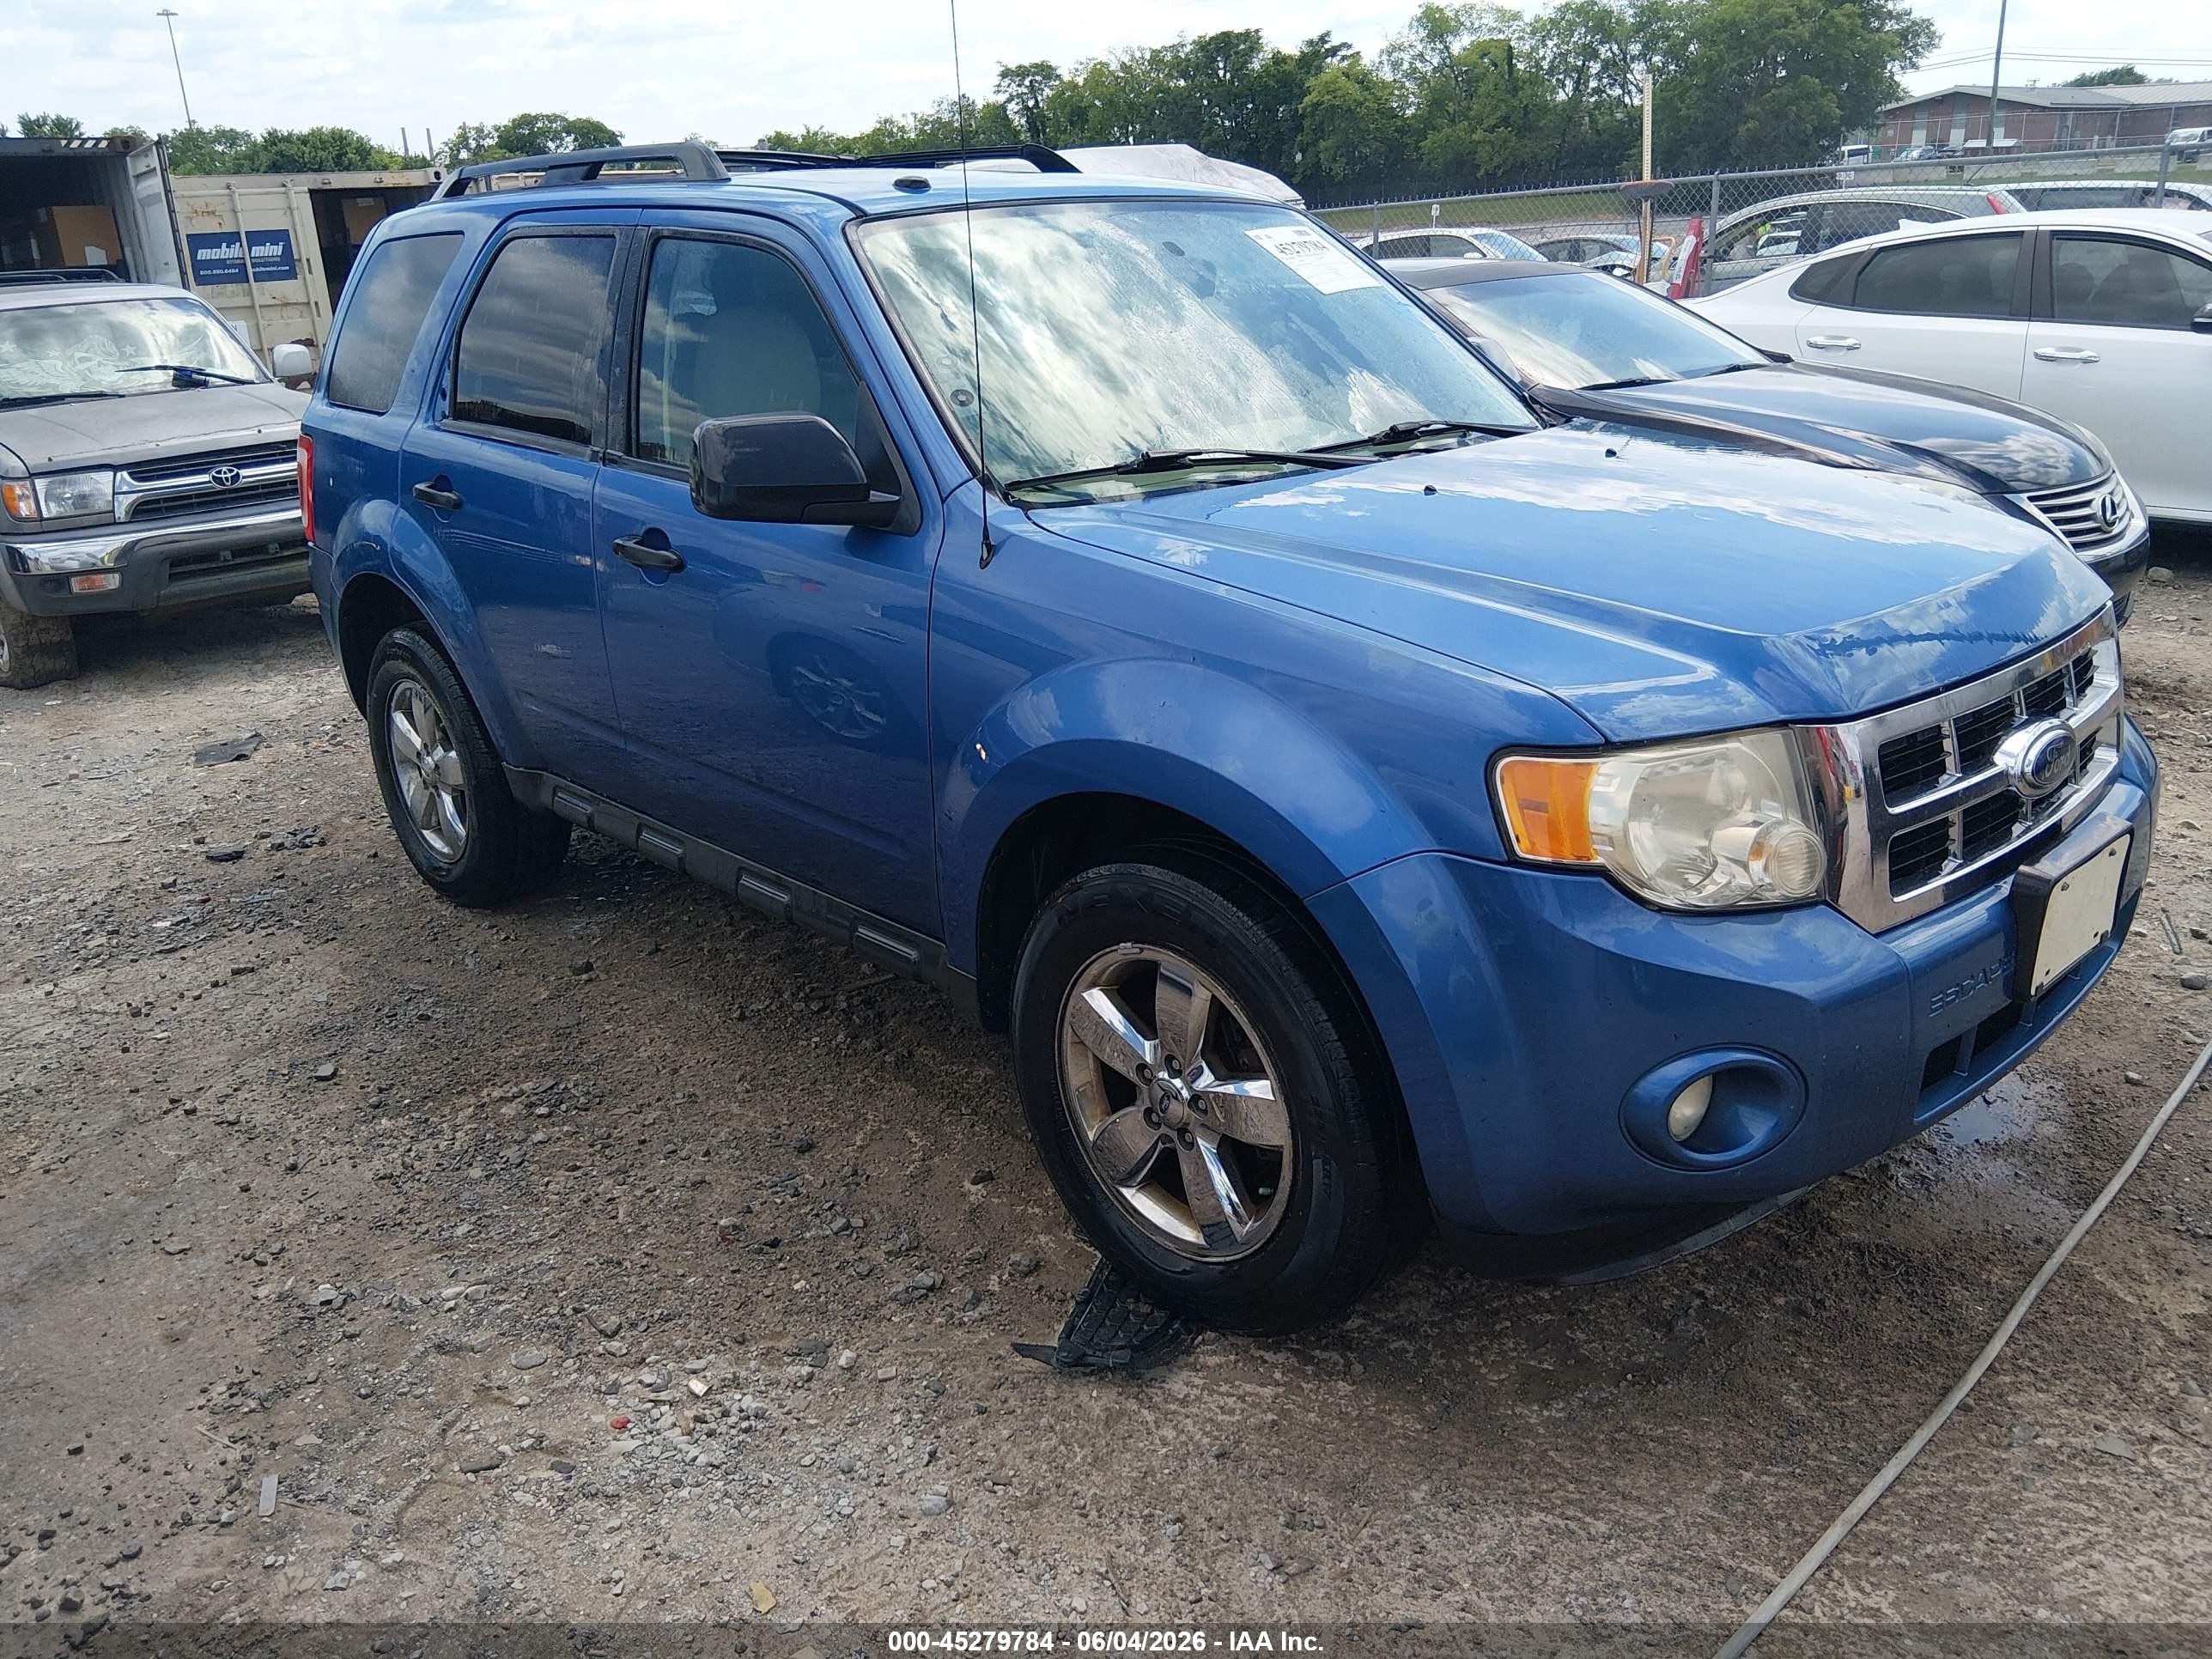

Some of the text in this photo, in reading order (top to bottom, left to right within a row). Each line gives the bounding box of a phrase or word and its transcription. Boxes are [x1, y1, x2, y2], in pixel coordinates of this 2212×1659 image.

[251, 241, 284, 258] mini
[1274, 240, 1330, 256] 45279784
[2045, 741, 2072, 778] Ford
